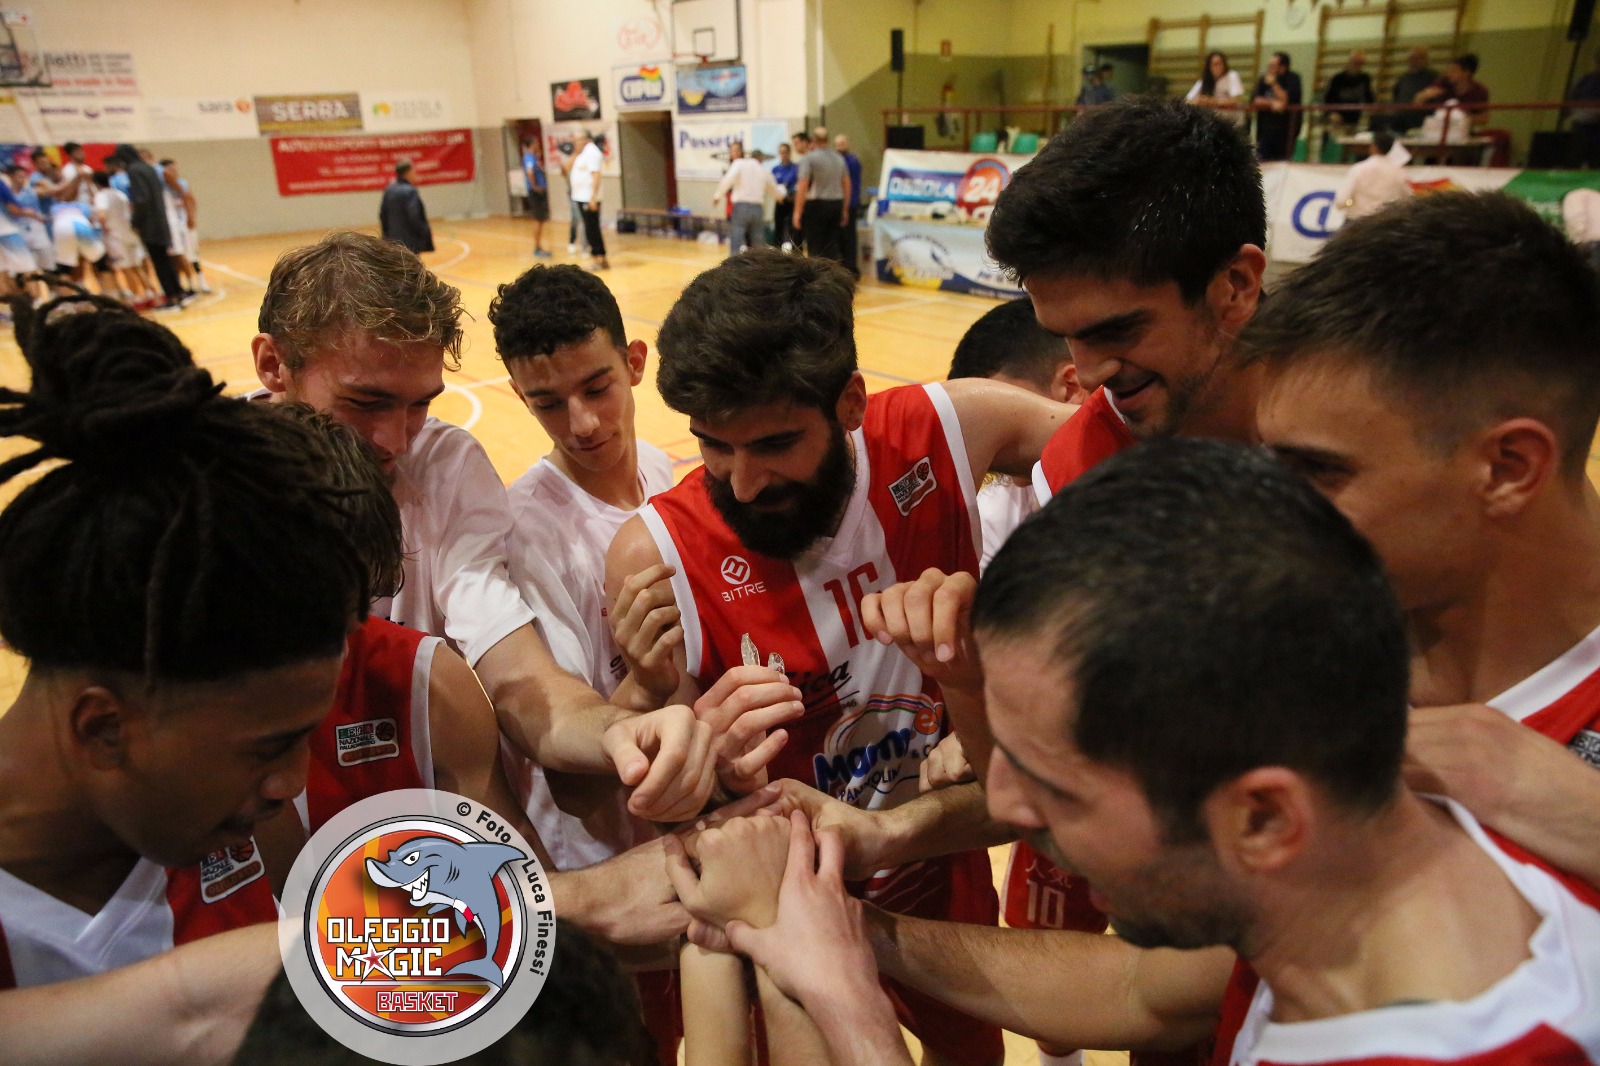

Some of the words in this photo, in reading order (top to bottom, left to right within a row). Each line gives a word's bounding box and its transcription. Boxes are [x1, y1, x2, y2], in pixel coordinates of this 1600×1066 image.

[270, 100, 349, 121] SERRA
[963, 175, 999, 204] 24
[721, 581, 767, 602] BITRE
[1026, 878, 1066, 929] 10
